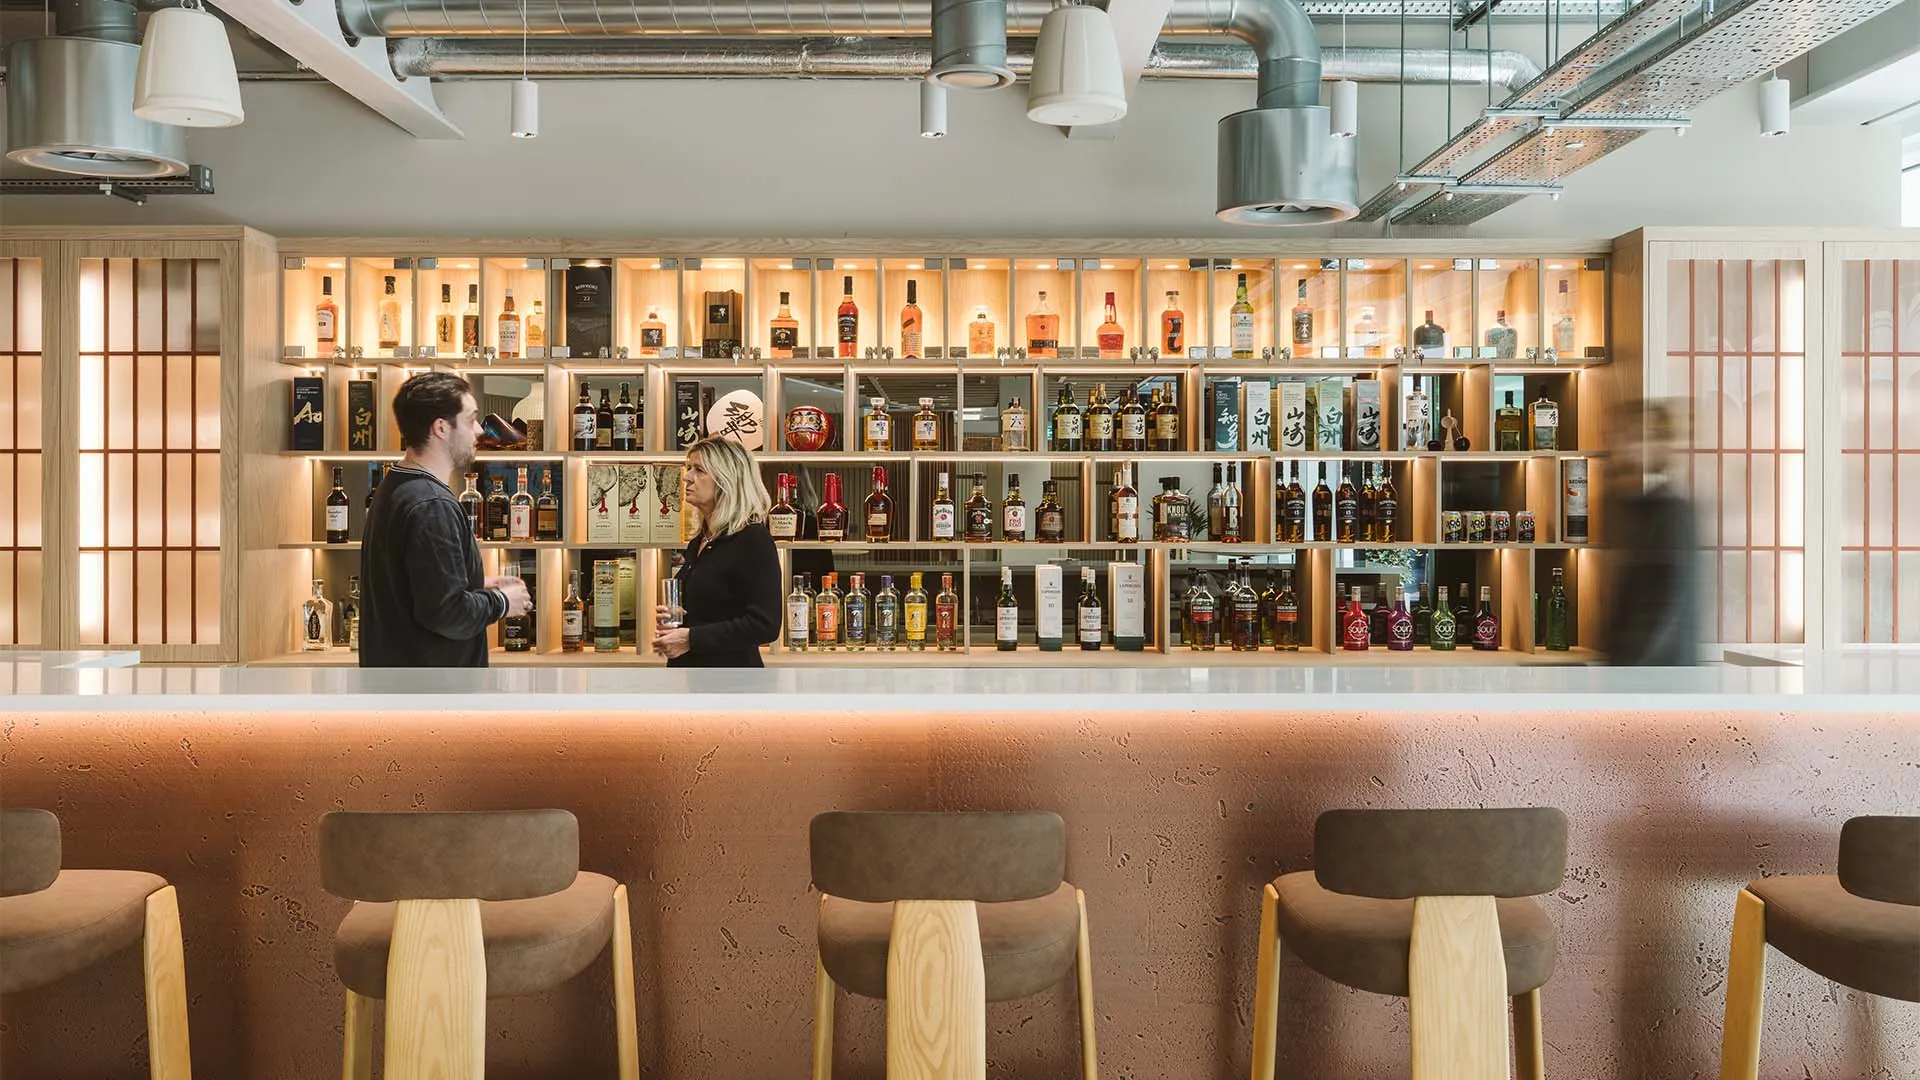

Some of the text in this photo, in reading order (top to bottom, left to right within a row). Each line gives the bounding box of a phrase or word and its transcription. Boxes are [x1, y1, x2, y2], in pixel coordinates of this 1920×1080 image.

[354, 408, 372, 449] 白州
[1251, 407, 1271, 449] 白州
[1283, 406, 1306, 447] 山崎
[1358, 406, 1380, 446] 山崎
[1167, 505, 1185, 514] KNOB
